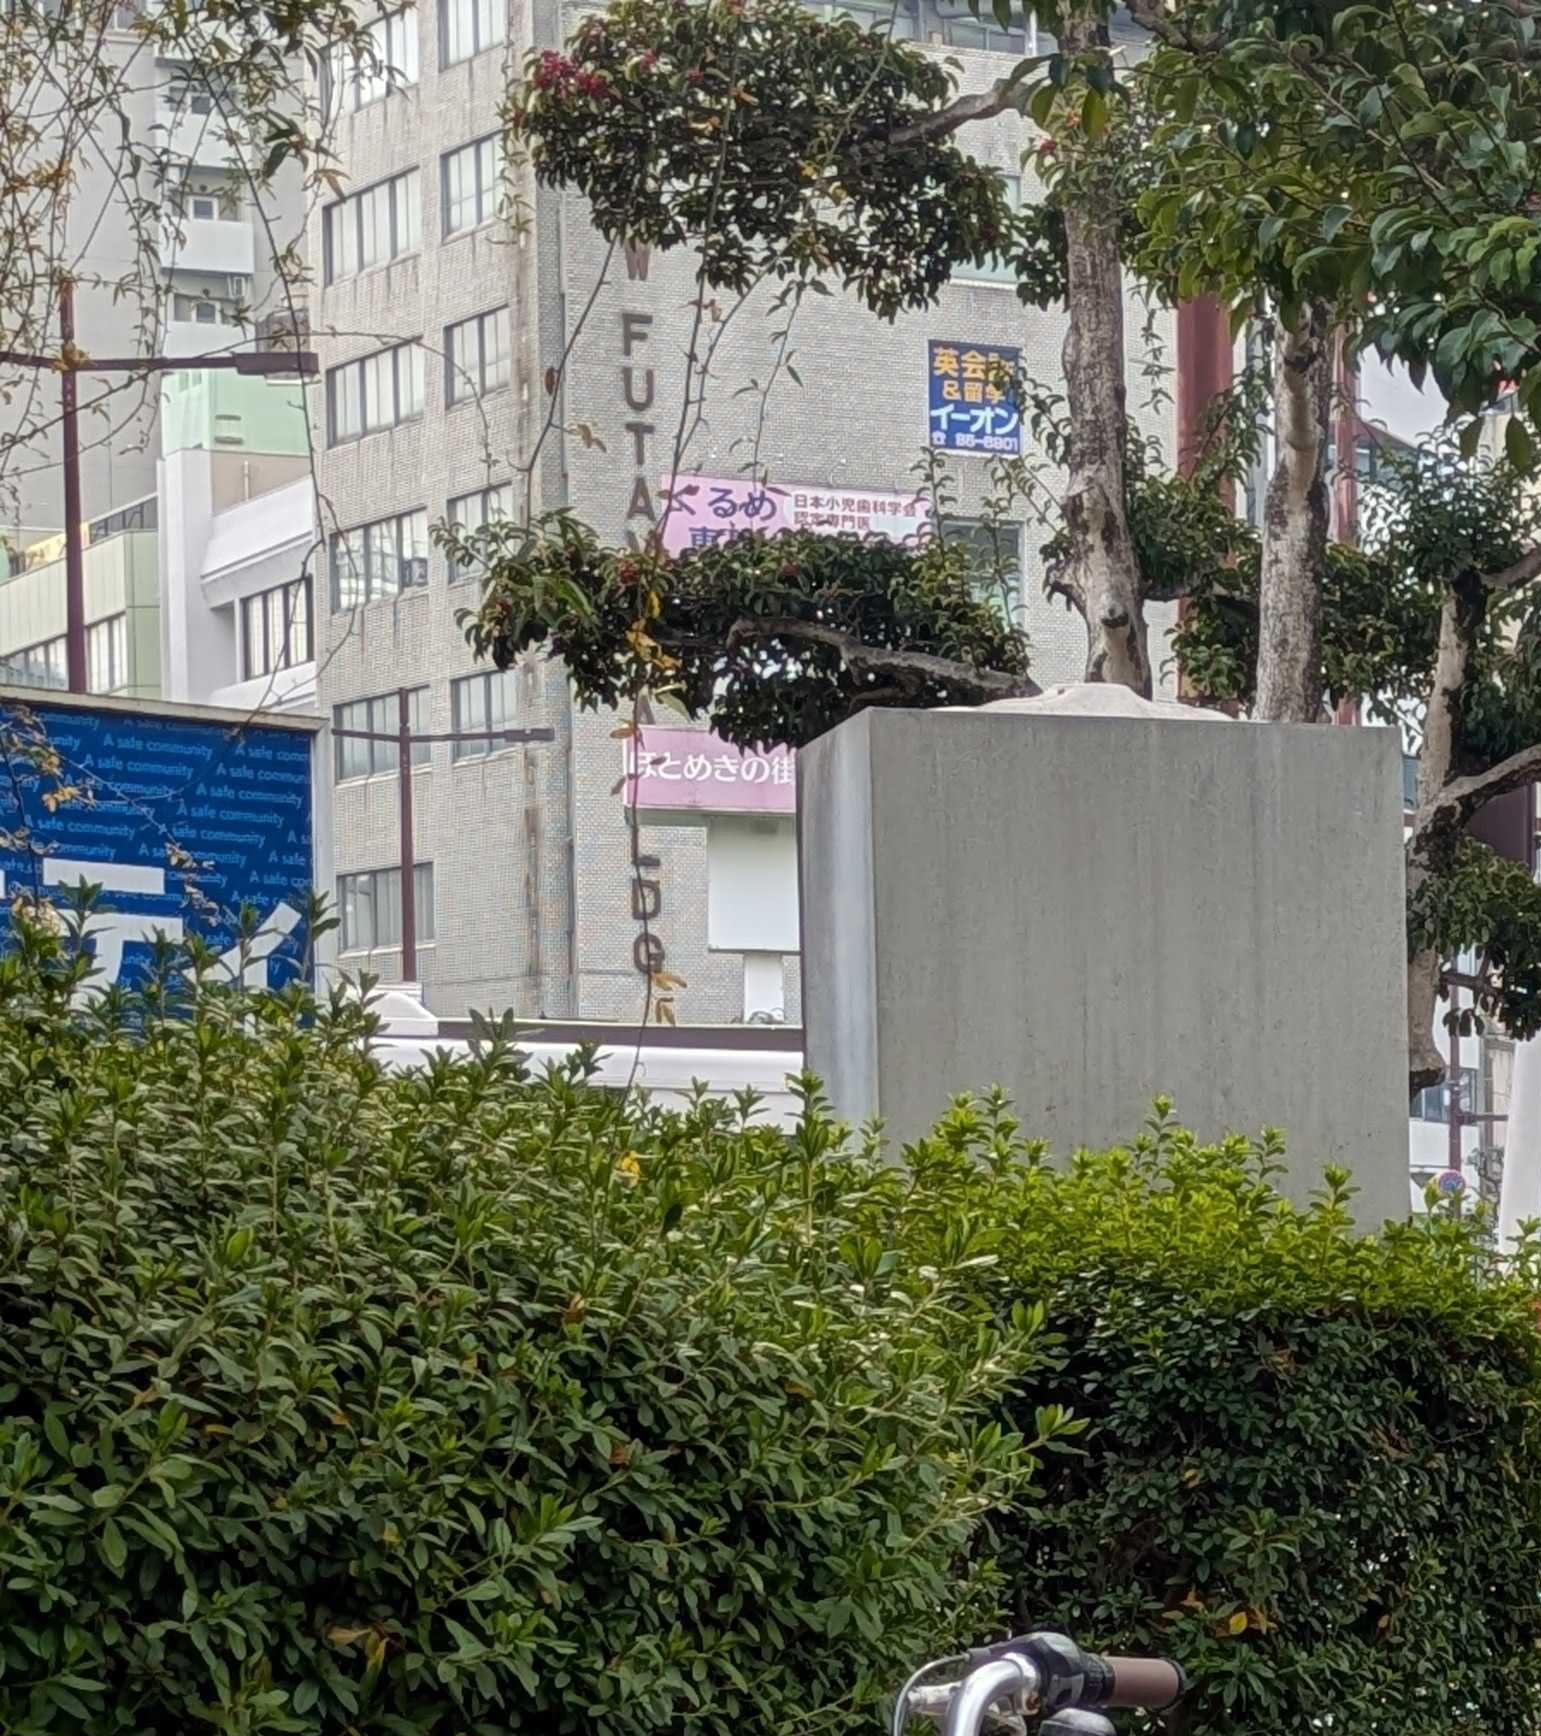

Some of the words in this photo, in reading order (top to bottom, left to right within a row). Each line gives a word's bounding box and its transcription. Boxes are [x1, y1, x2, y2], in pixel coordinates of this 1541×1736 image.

[930, 404, 1019, 434] イーオン
[127, 759, 194, 780] community
[238, 790, 304, 810] community
[219, 808, 285, 829] community
[67, 820, 136, 841] community
[200, 829, 267, 849] community
